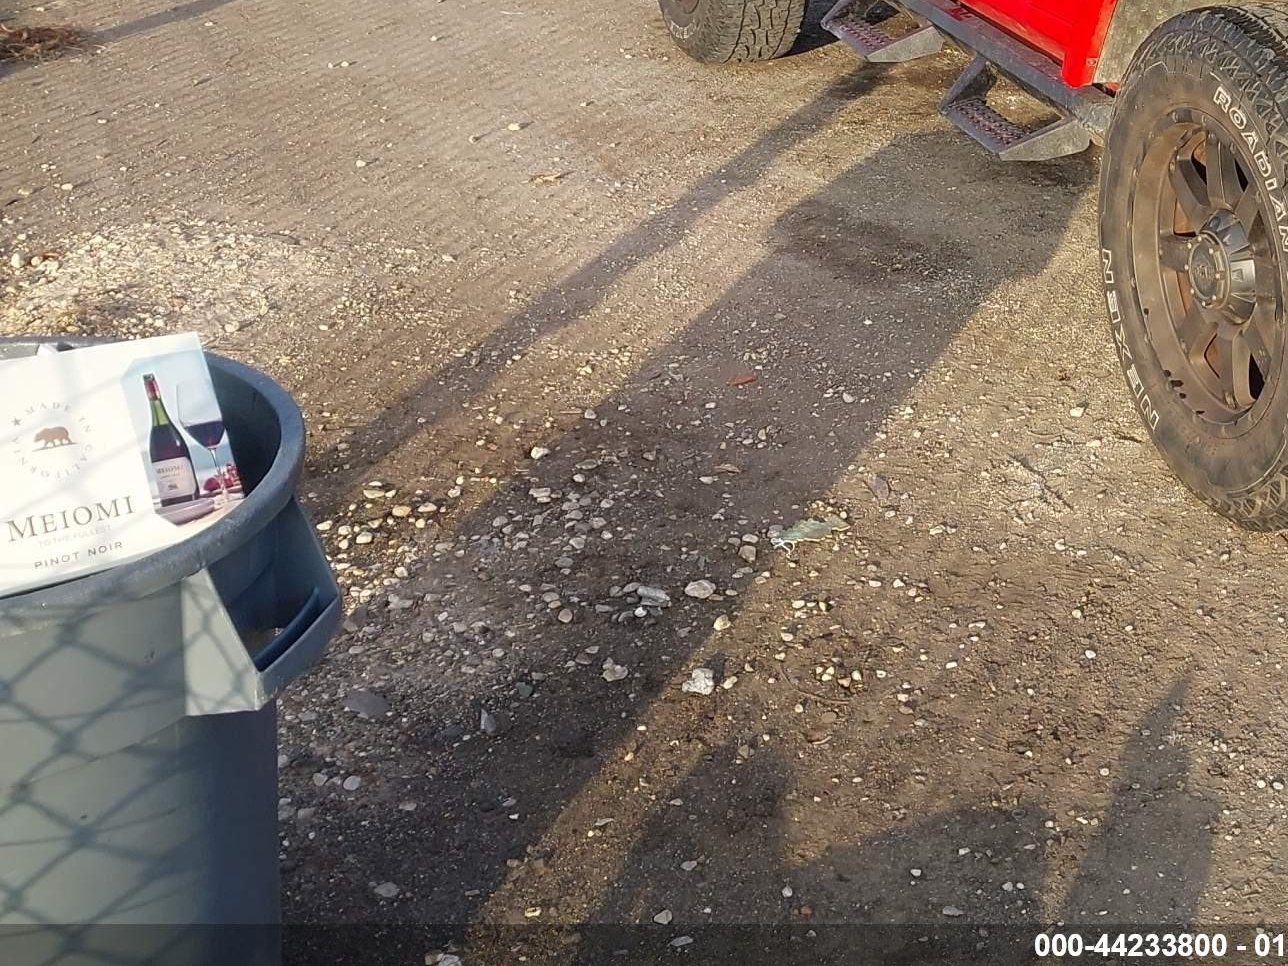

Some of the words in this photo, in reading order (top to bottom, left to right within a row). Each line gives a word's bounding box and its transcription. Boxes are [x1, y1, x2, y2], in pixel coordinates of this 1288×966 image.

[1101, 248, 1160, 431] NEXEN
[4, 495, 136, 543] MEIOMI
[34, 551, 80, 570] PINOT
[87, 541, 124, 557] NOIR
